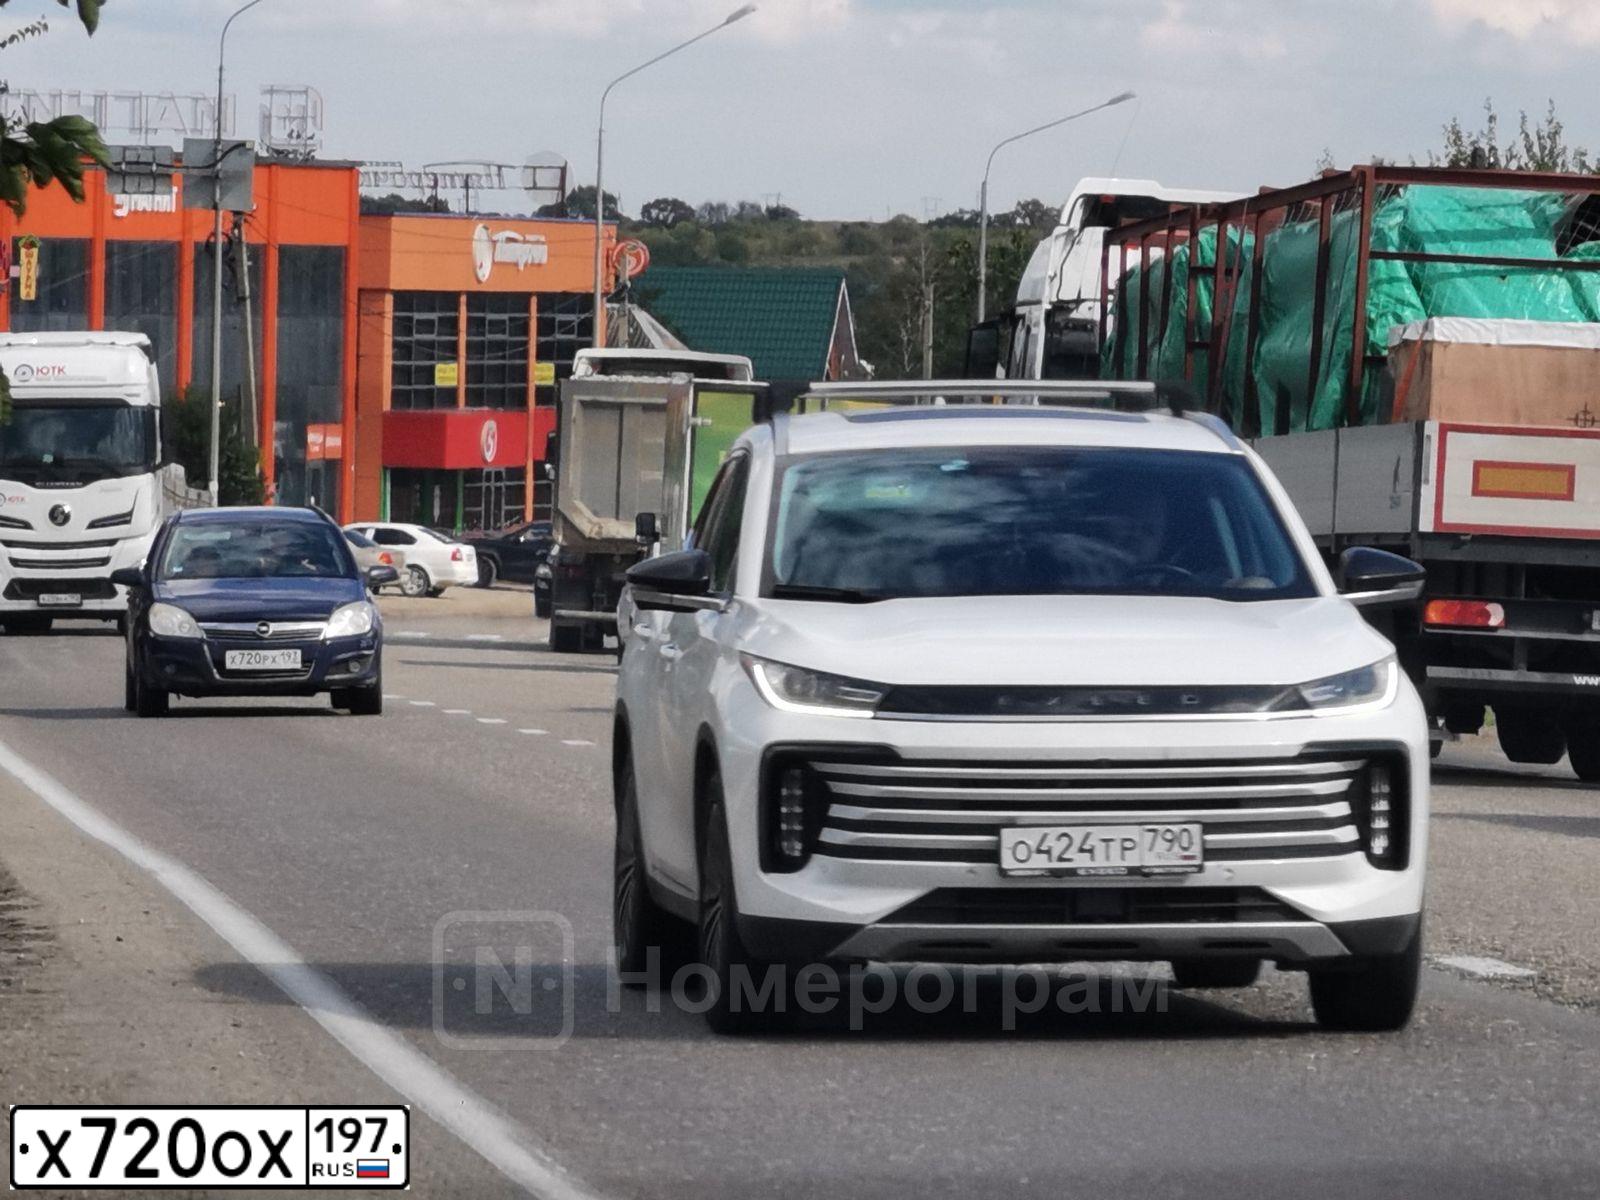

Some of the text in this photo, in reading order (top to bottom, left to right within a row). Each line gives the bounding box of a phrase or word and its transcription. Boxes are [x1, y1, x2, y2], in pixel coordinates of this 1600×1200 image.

[36, 365, 66, 376] ЮТК
[1572, 674, 1600, 686] ww
[1011, 827, 1194, 864] О424ТР 790
